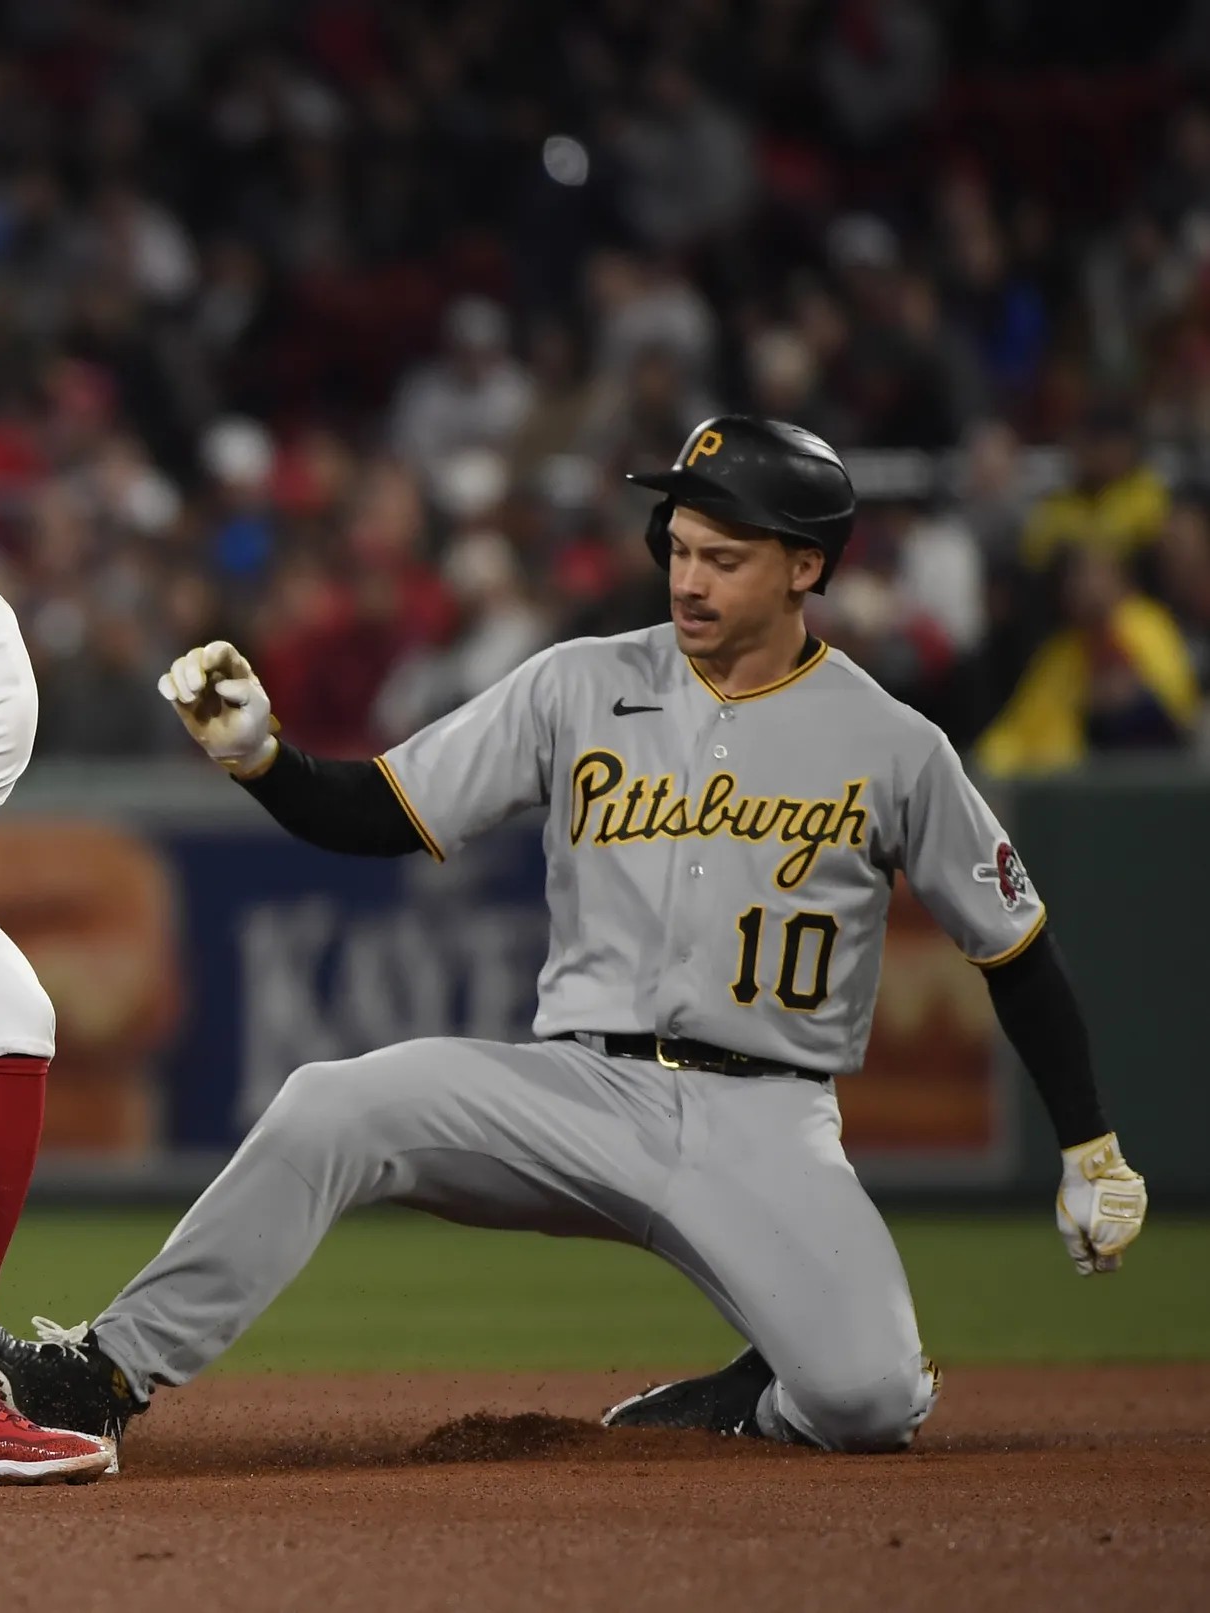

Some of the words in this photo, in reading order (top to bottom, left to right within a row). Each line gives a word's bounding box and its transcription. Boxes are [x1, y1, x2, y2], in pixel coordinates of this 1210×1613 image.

[687, 430, 723, 466] P
[570, 747, 869, 889] Pittsburgh
[730, 904, 839, 1012] 10
